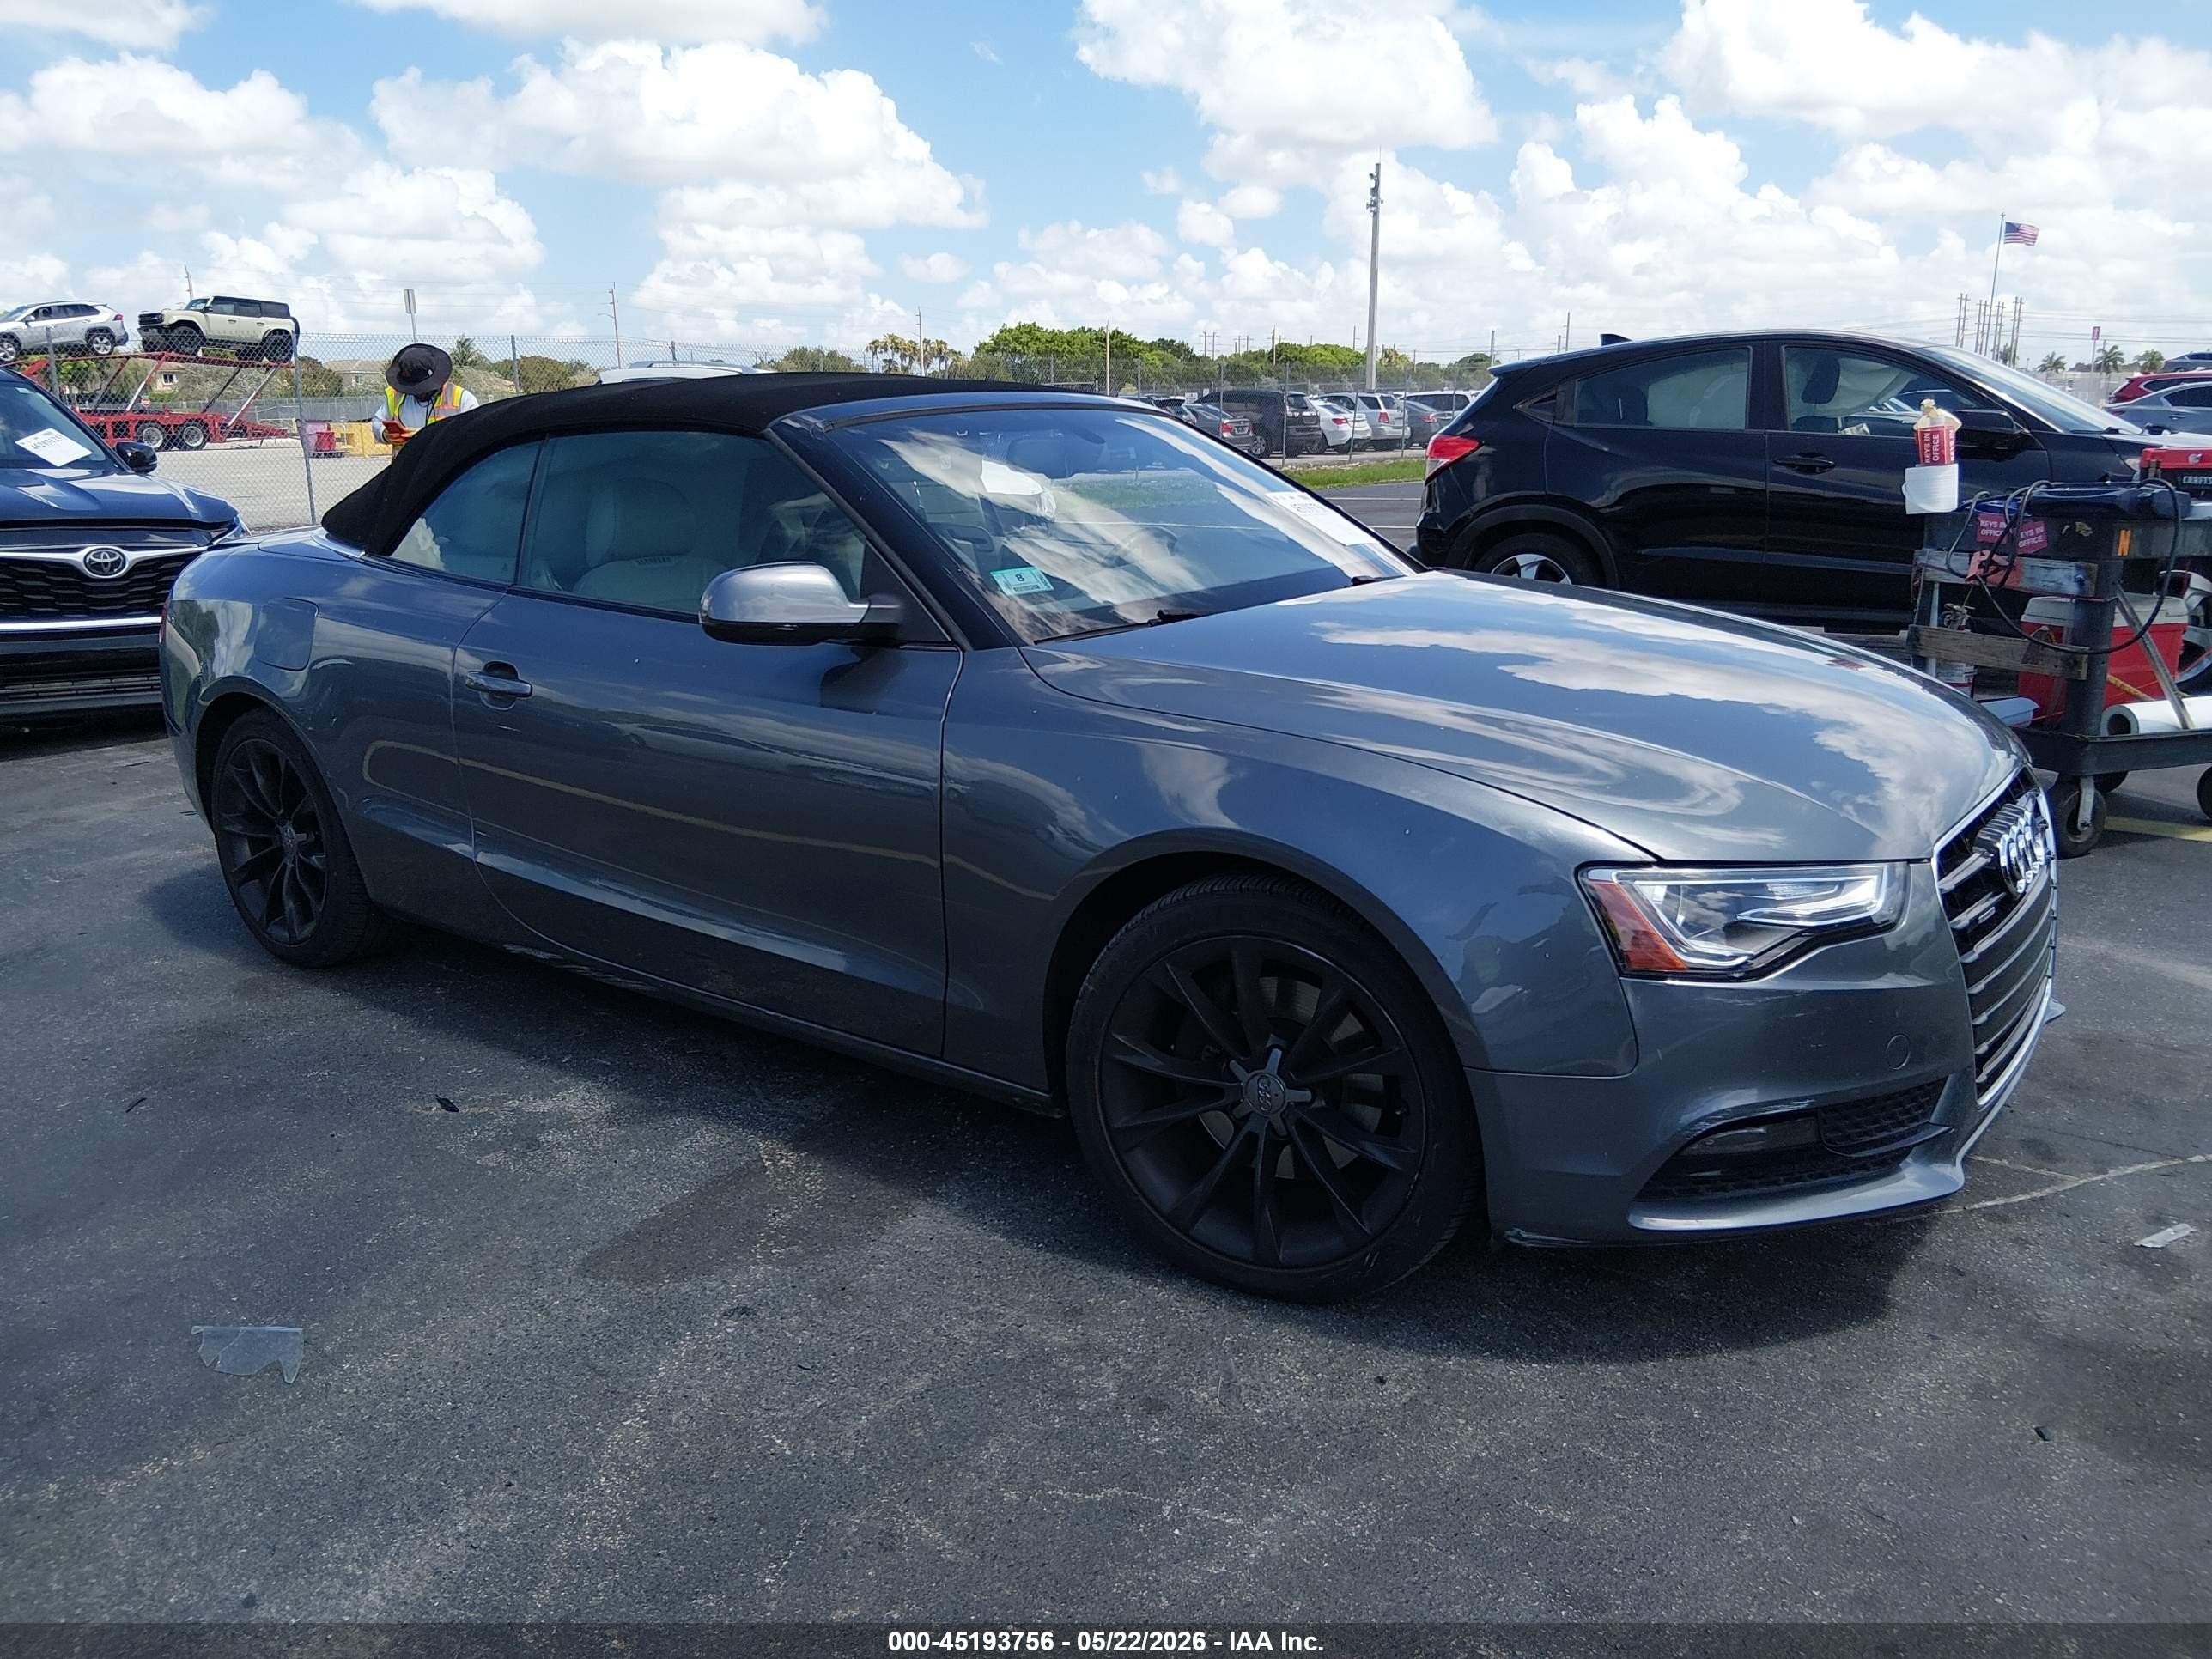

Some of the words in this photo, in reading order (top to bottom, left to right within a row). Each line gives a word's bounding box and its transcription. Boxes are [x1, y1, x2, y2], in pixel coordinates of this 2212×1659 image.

[1924, 432, 1930, 441] IN
[1980, 528, 2004, 537] OFFIC
[2020, 529, 2034, 538] EYS
[2018, 535, 2044, 547] OFFICE
